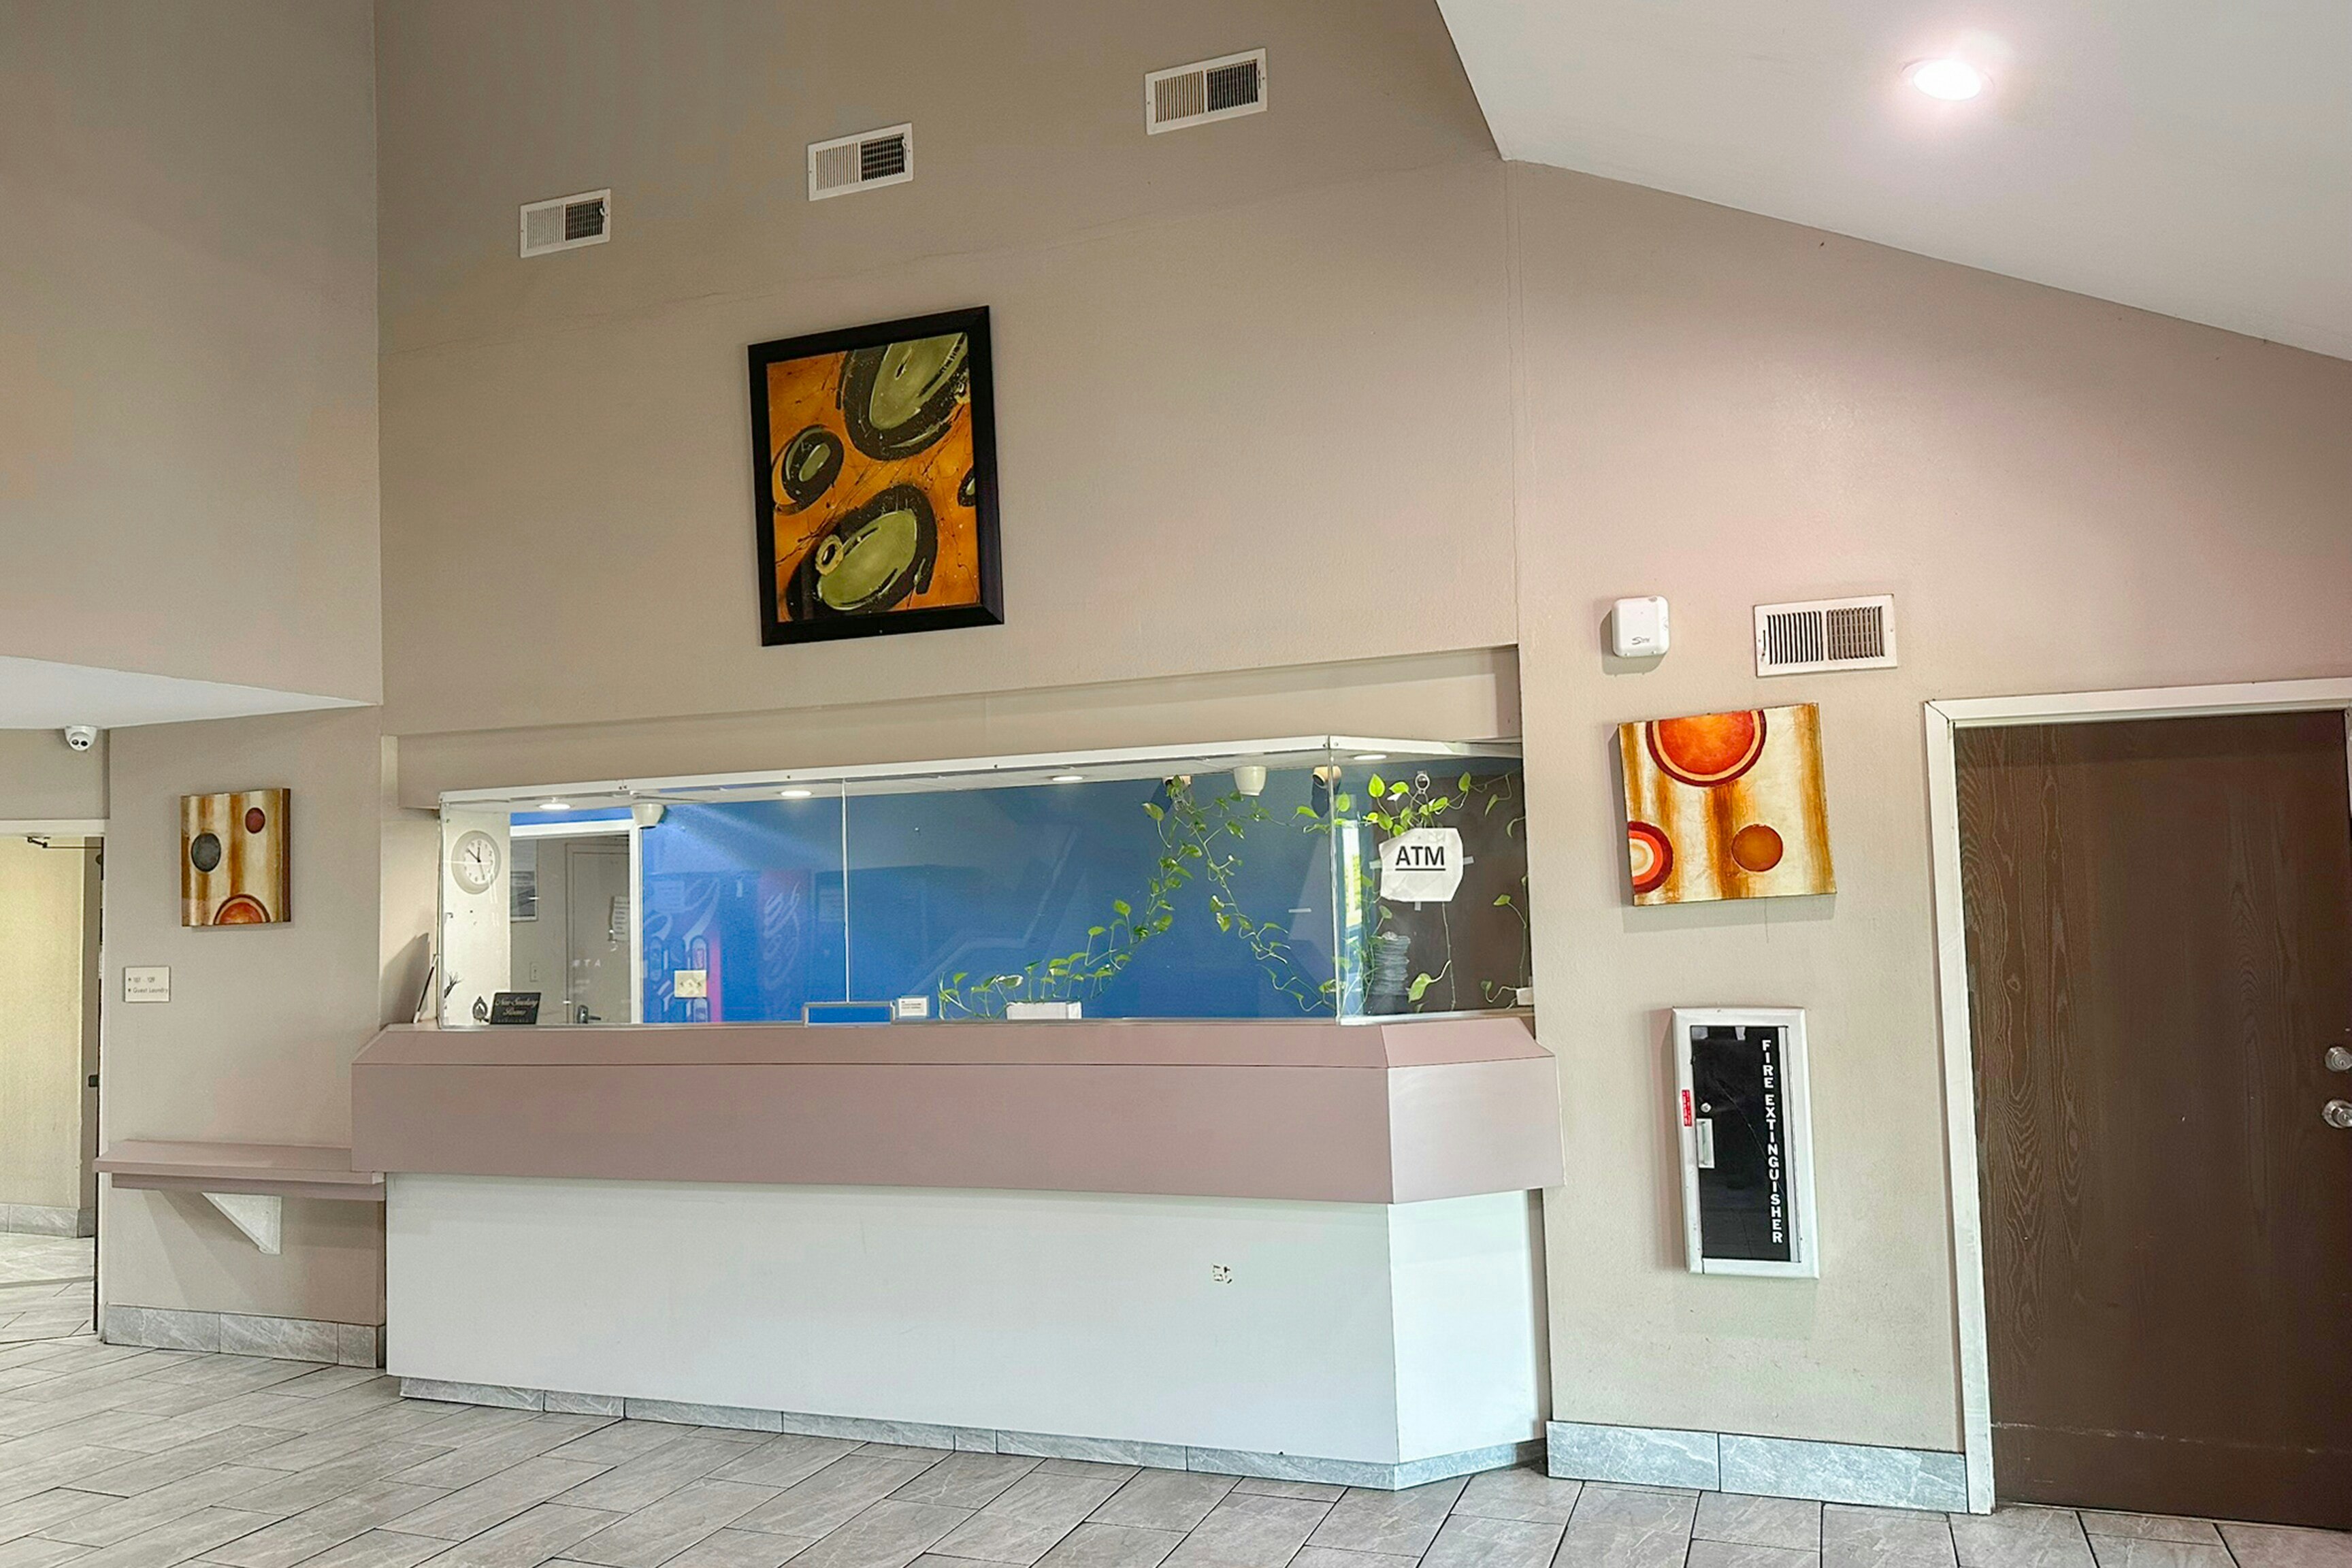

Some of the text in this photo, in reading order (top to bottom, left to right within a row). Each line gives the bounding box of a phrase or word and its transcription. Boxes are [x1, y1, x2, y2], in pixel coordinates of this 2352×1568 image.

[1395, 845, 1445, 866] ATM
[1761, 1039, 1784, 1244] FIRE EXTINGUISHER
